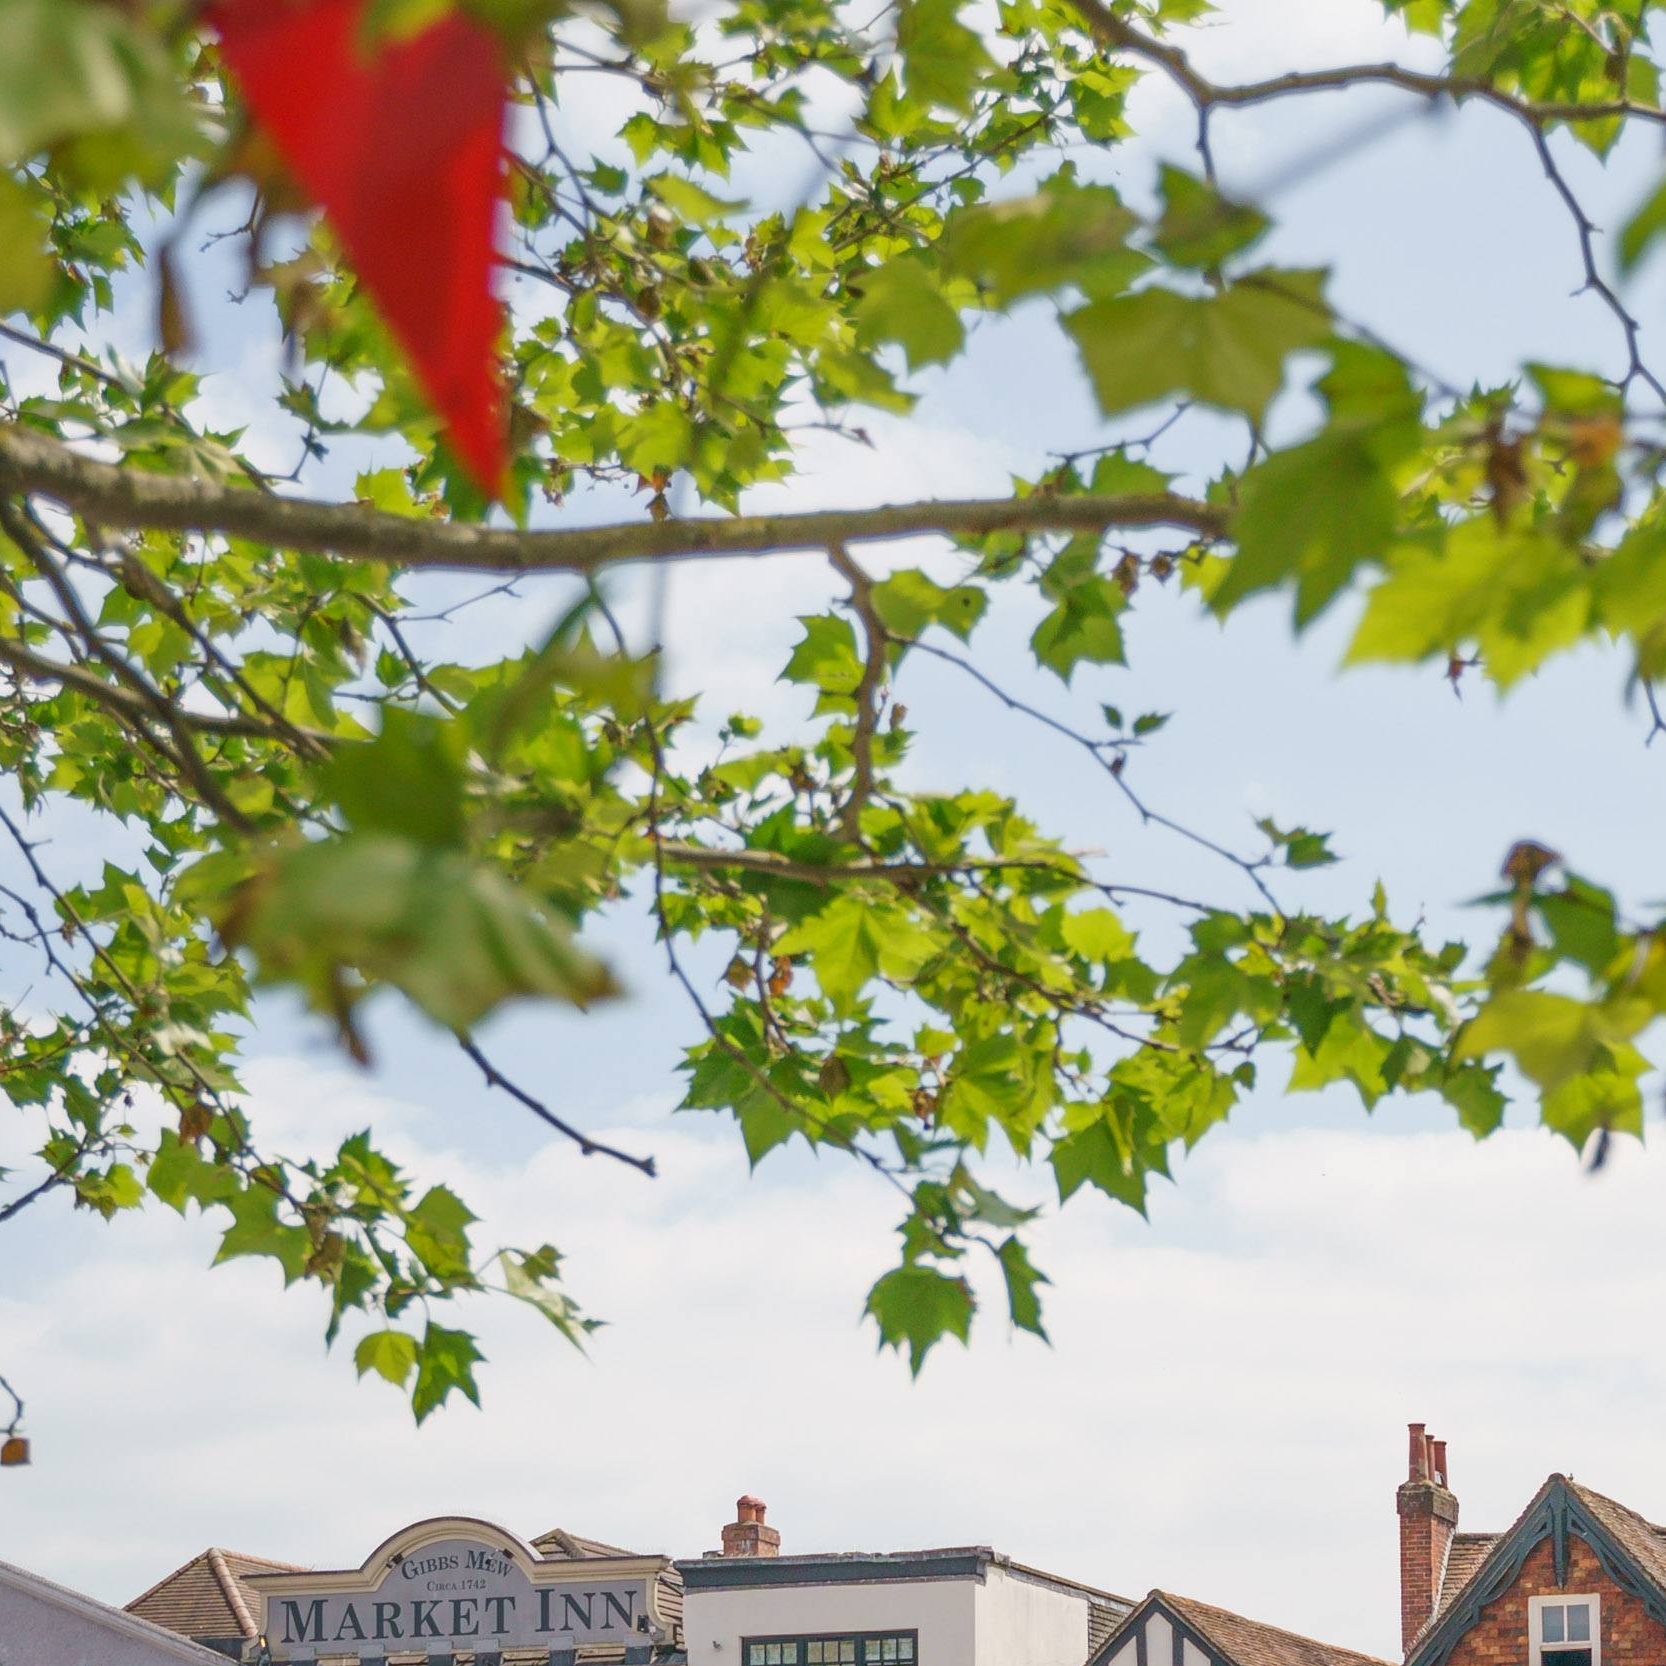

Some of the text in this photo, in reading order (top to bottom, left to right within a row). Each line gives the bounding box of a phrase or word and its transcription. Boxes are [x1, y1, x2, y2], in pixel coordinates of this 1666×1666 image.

[400, 1549, 515, 1581] GIBBS MEW
[461, 1578, 487, 1591] 1742
[280, 1588, 638, 1644] MARKET INN
